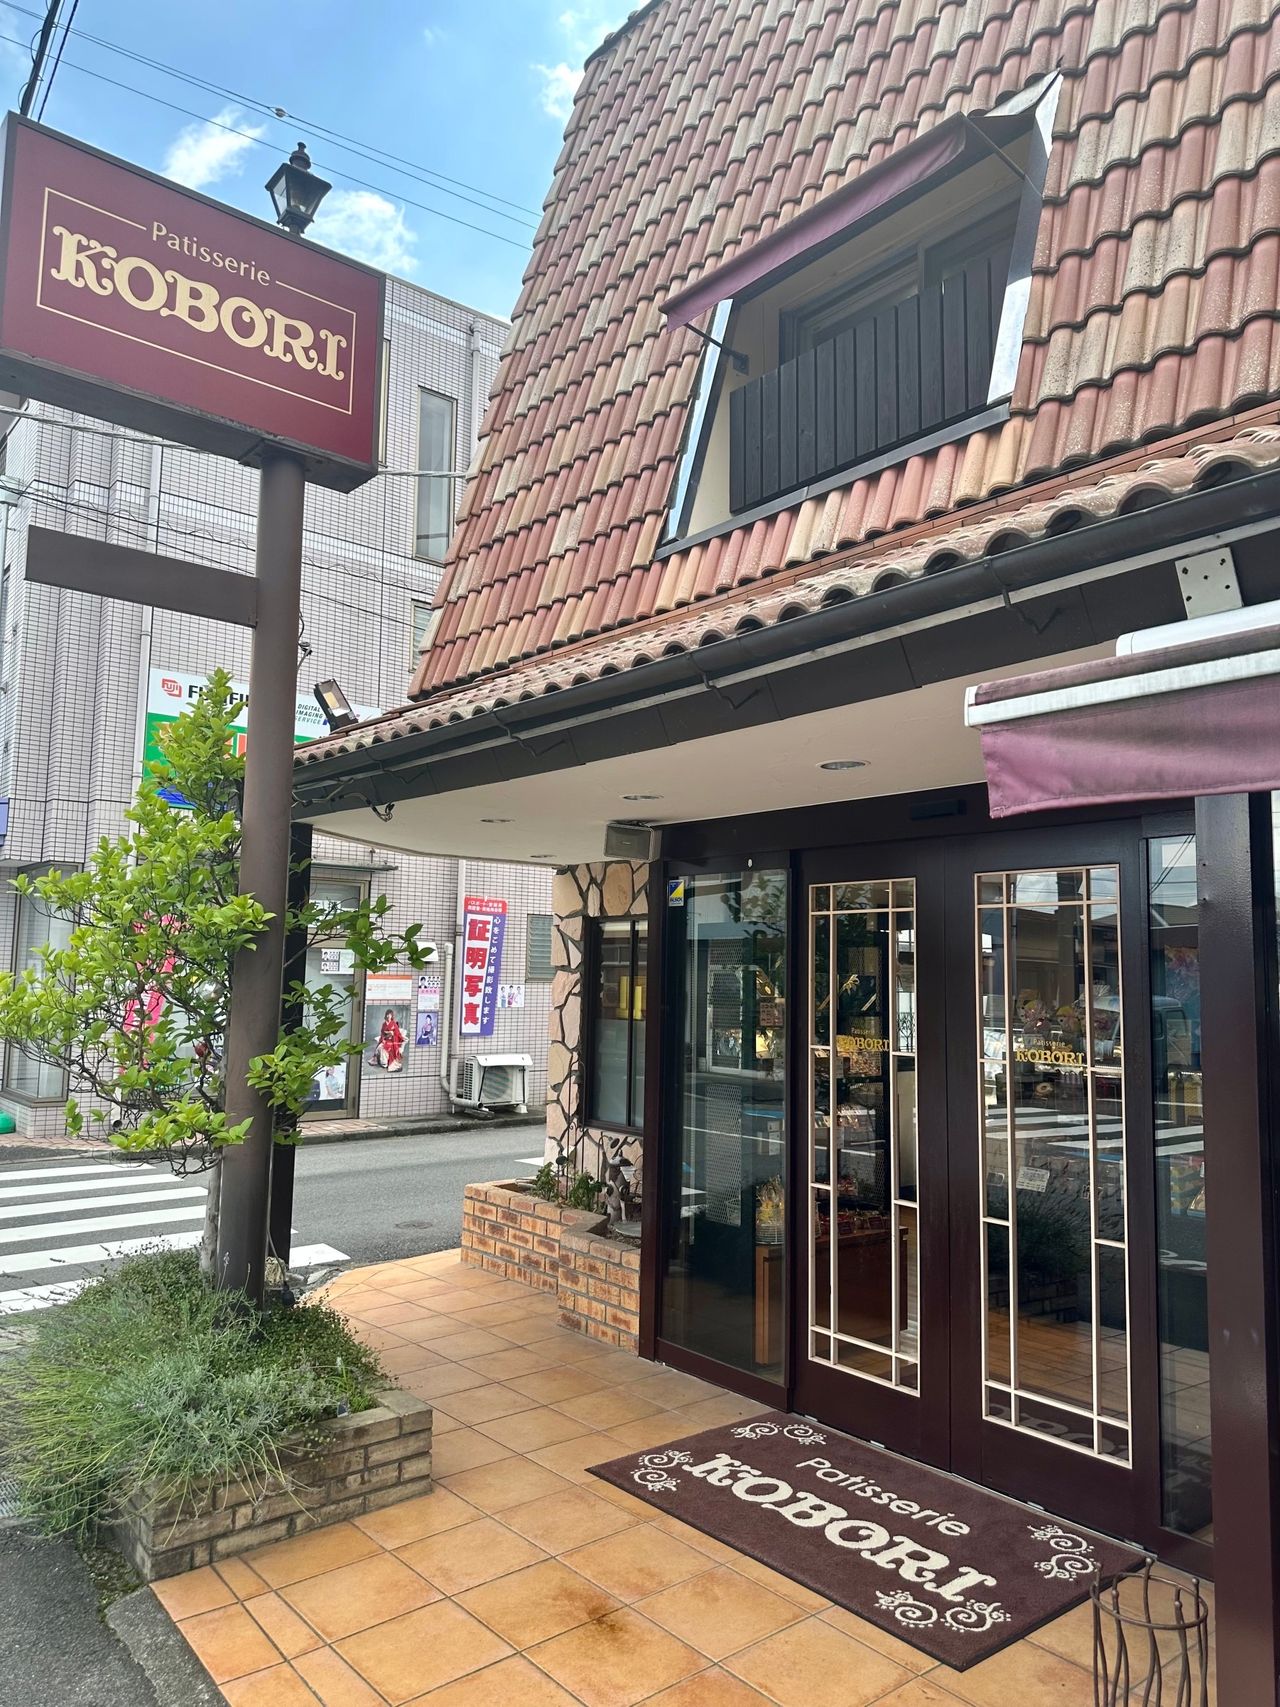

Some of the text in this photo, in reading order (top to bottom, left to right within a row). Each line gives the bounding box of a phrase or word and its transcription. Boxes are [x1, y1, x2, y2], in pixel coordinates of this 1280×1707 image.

[152, 221, 272, 286] Patisserie
[50, 225, 347, 380] KOBORI
[296, 710, 323, 718] IMAGING
[298, 704, 321, 712] DIGITAL
[463, 918, 492, 1025] 証明写真
[1015, 1048, 1085, 1067] KOBORI
[681, 1453, 997, 1601] KOBORI
[795, 1457, 970, 1536] Patisserie
